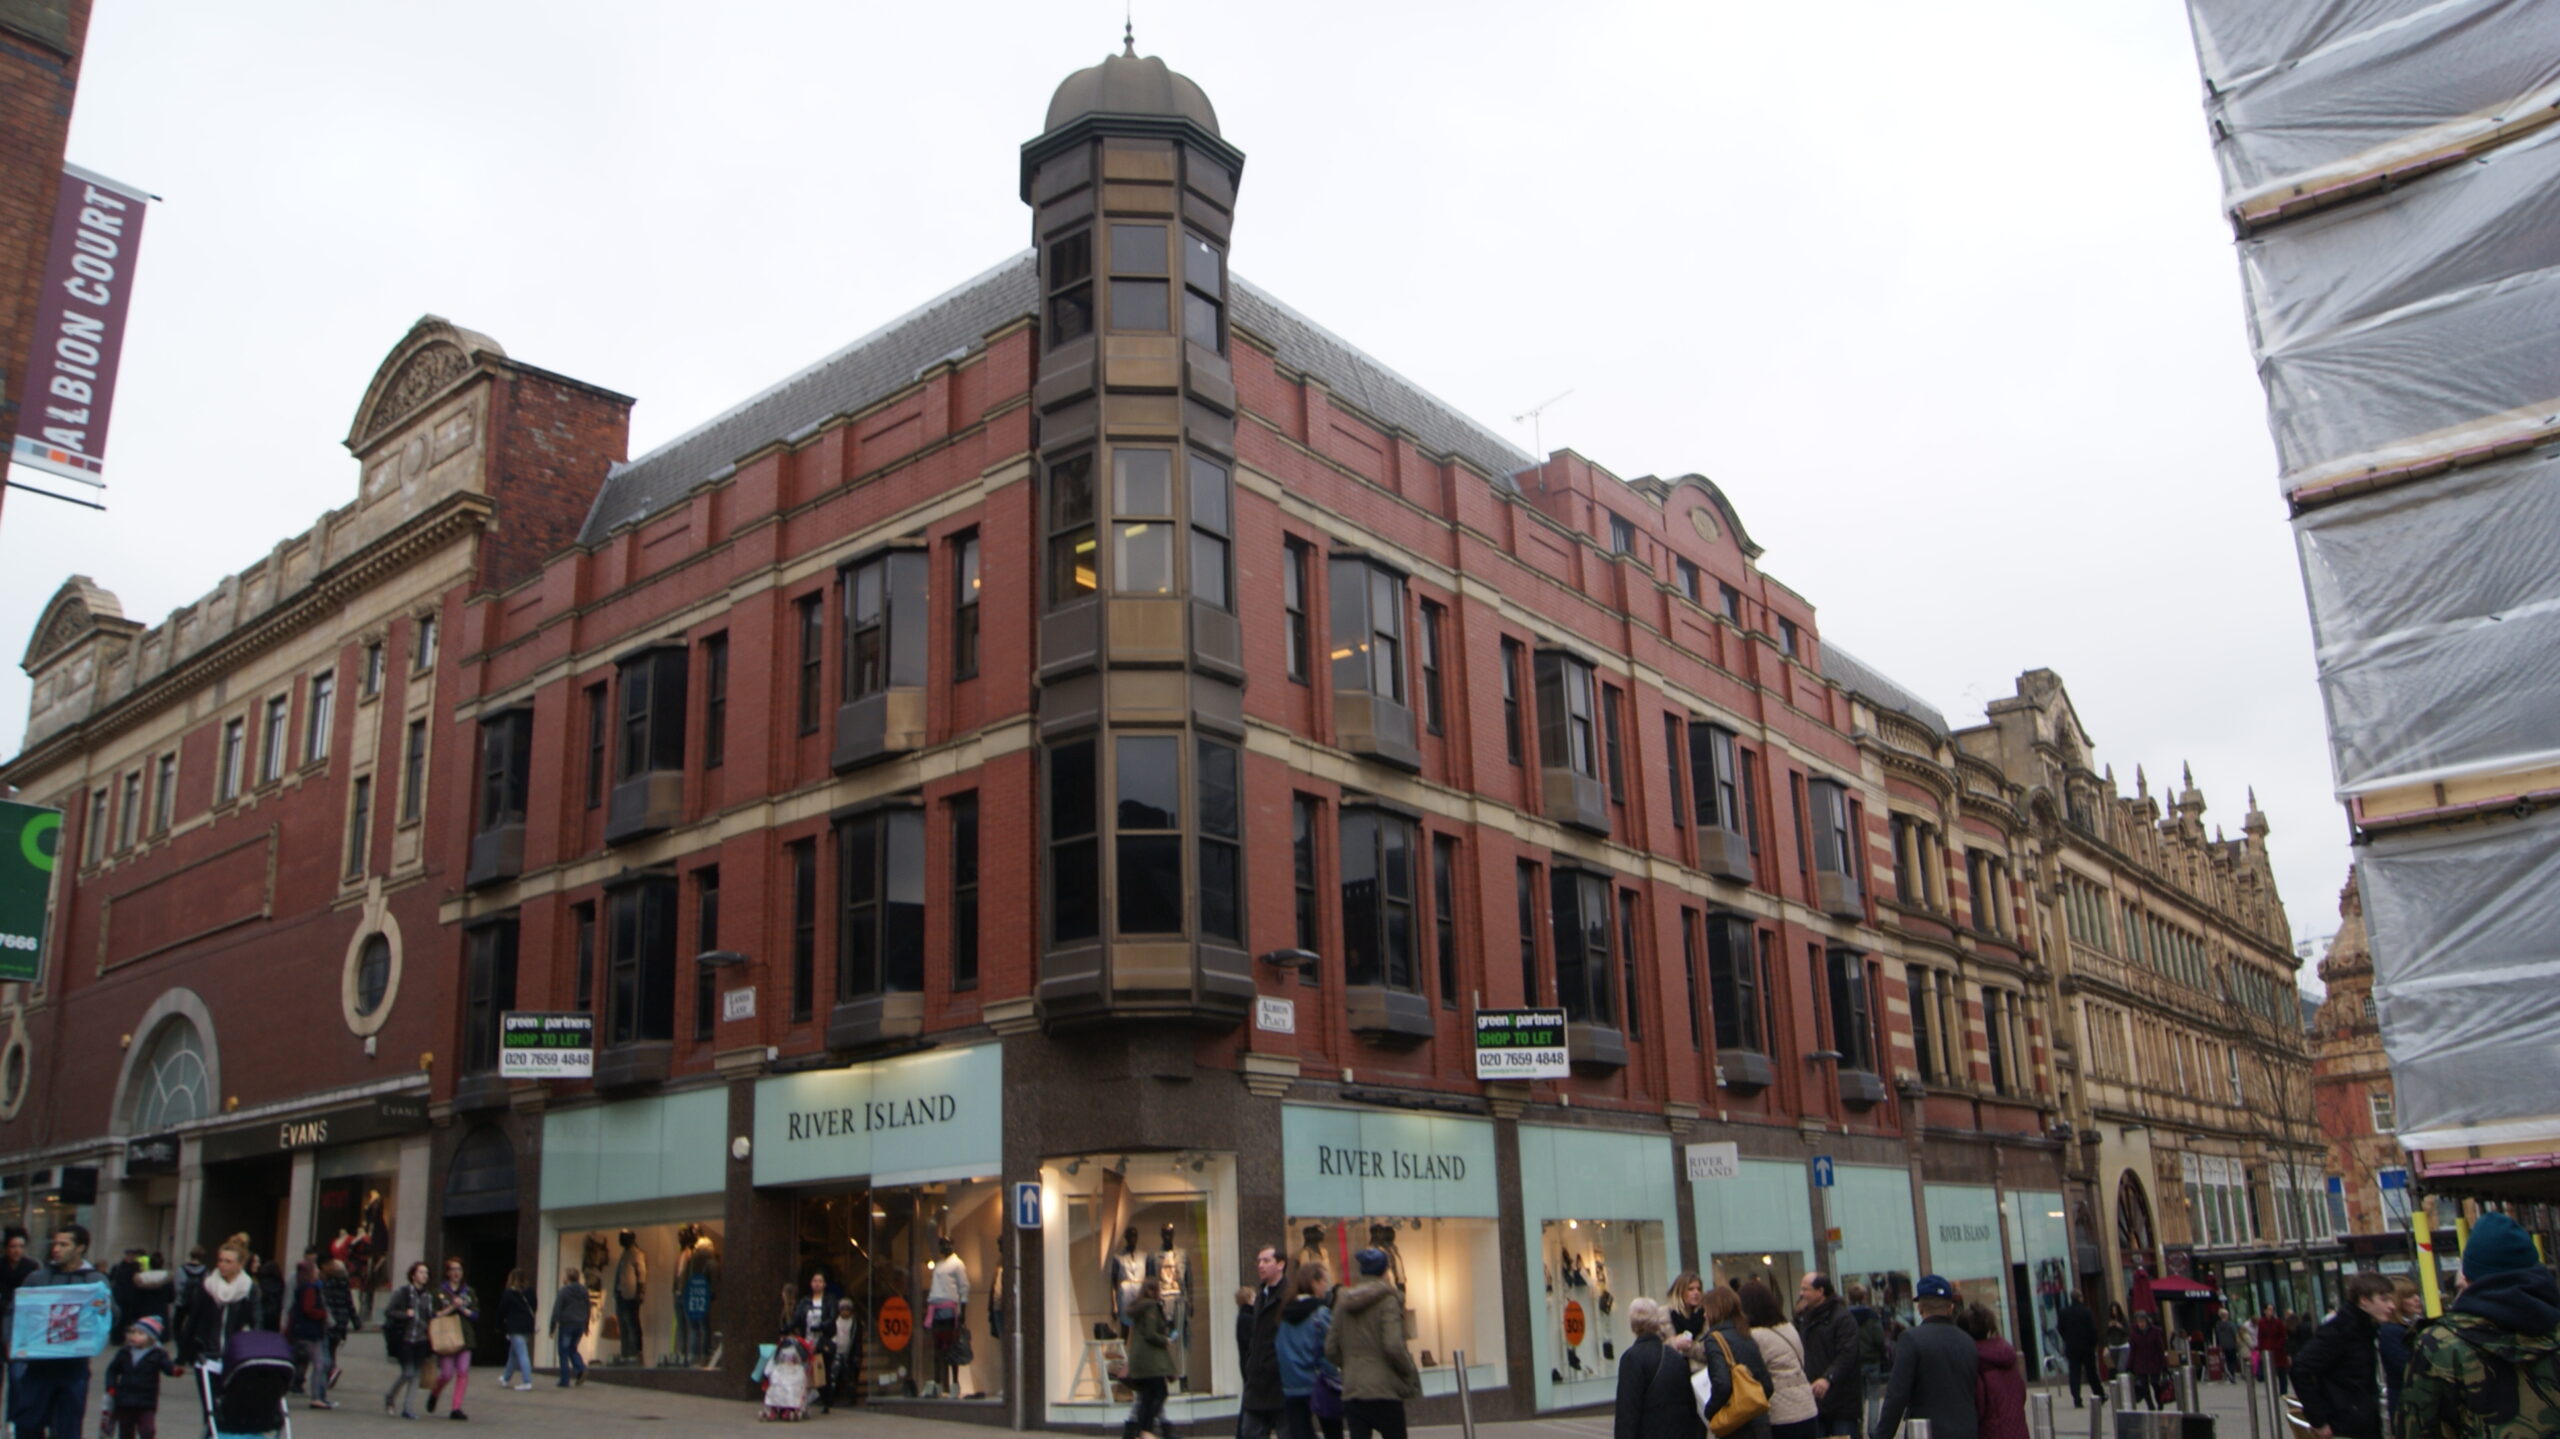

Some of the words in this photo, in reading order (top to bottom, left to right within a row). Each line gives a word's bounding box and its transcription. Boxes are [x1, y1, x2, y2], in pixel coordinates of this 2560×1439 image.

[62, 184, 127, 307] COURT
[42, 309, 106, 453] ALBION
[506, 1033, 538, 1046] SHOP
[542, 1033, 557, 1046] TO
[560, 1033, 580, 1046] LET
[1479, 1031, 1510, 1045] SHOP
[1514, 1031, 1529, 1045] TO
[1532, 1031, 1553, 1045] LET
[505, 1053, 527, 1065] 020
[530, 1053, 558, 1065] 7659
[561, 1053, 590, 1065] 4848
[1480, 1053, 1501, 1066] 020
[1504, 1052, 1532, 1066] 7659
[1536, 1051, 1564, 1065] 4848
[382, 1103, 420, 1117] EVANS
[788, 1108, 855, 1141] RIVER
[865, 1093, 956, 1132] ISLAND
[280, 1120, 327, 1149] EVANS
[1318, 1145, 1385, 1178] RIVER
[1393, 1150, 1466, 1180] ISLAND
[1689, 1156, 1723, 1168] RIVER
[1690, 1167, 1733, 1178] ISLAND
[1939, 1225, 1961, 1242] RIVER
[1963, 1224, 1990, 1242] ISLAND
[2185, 1289, 2211, 1298] COSTA
